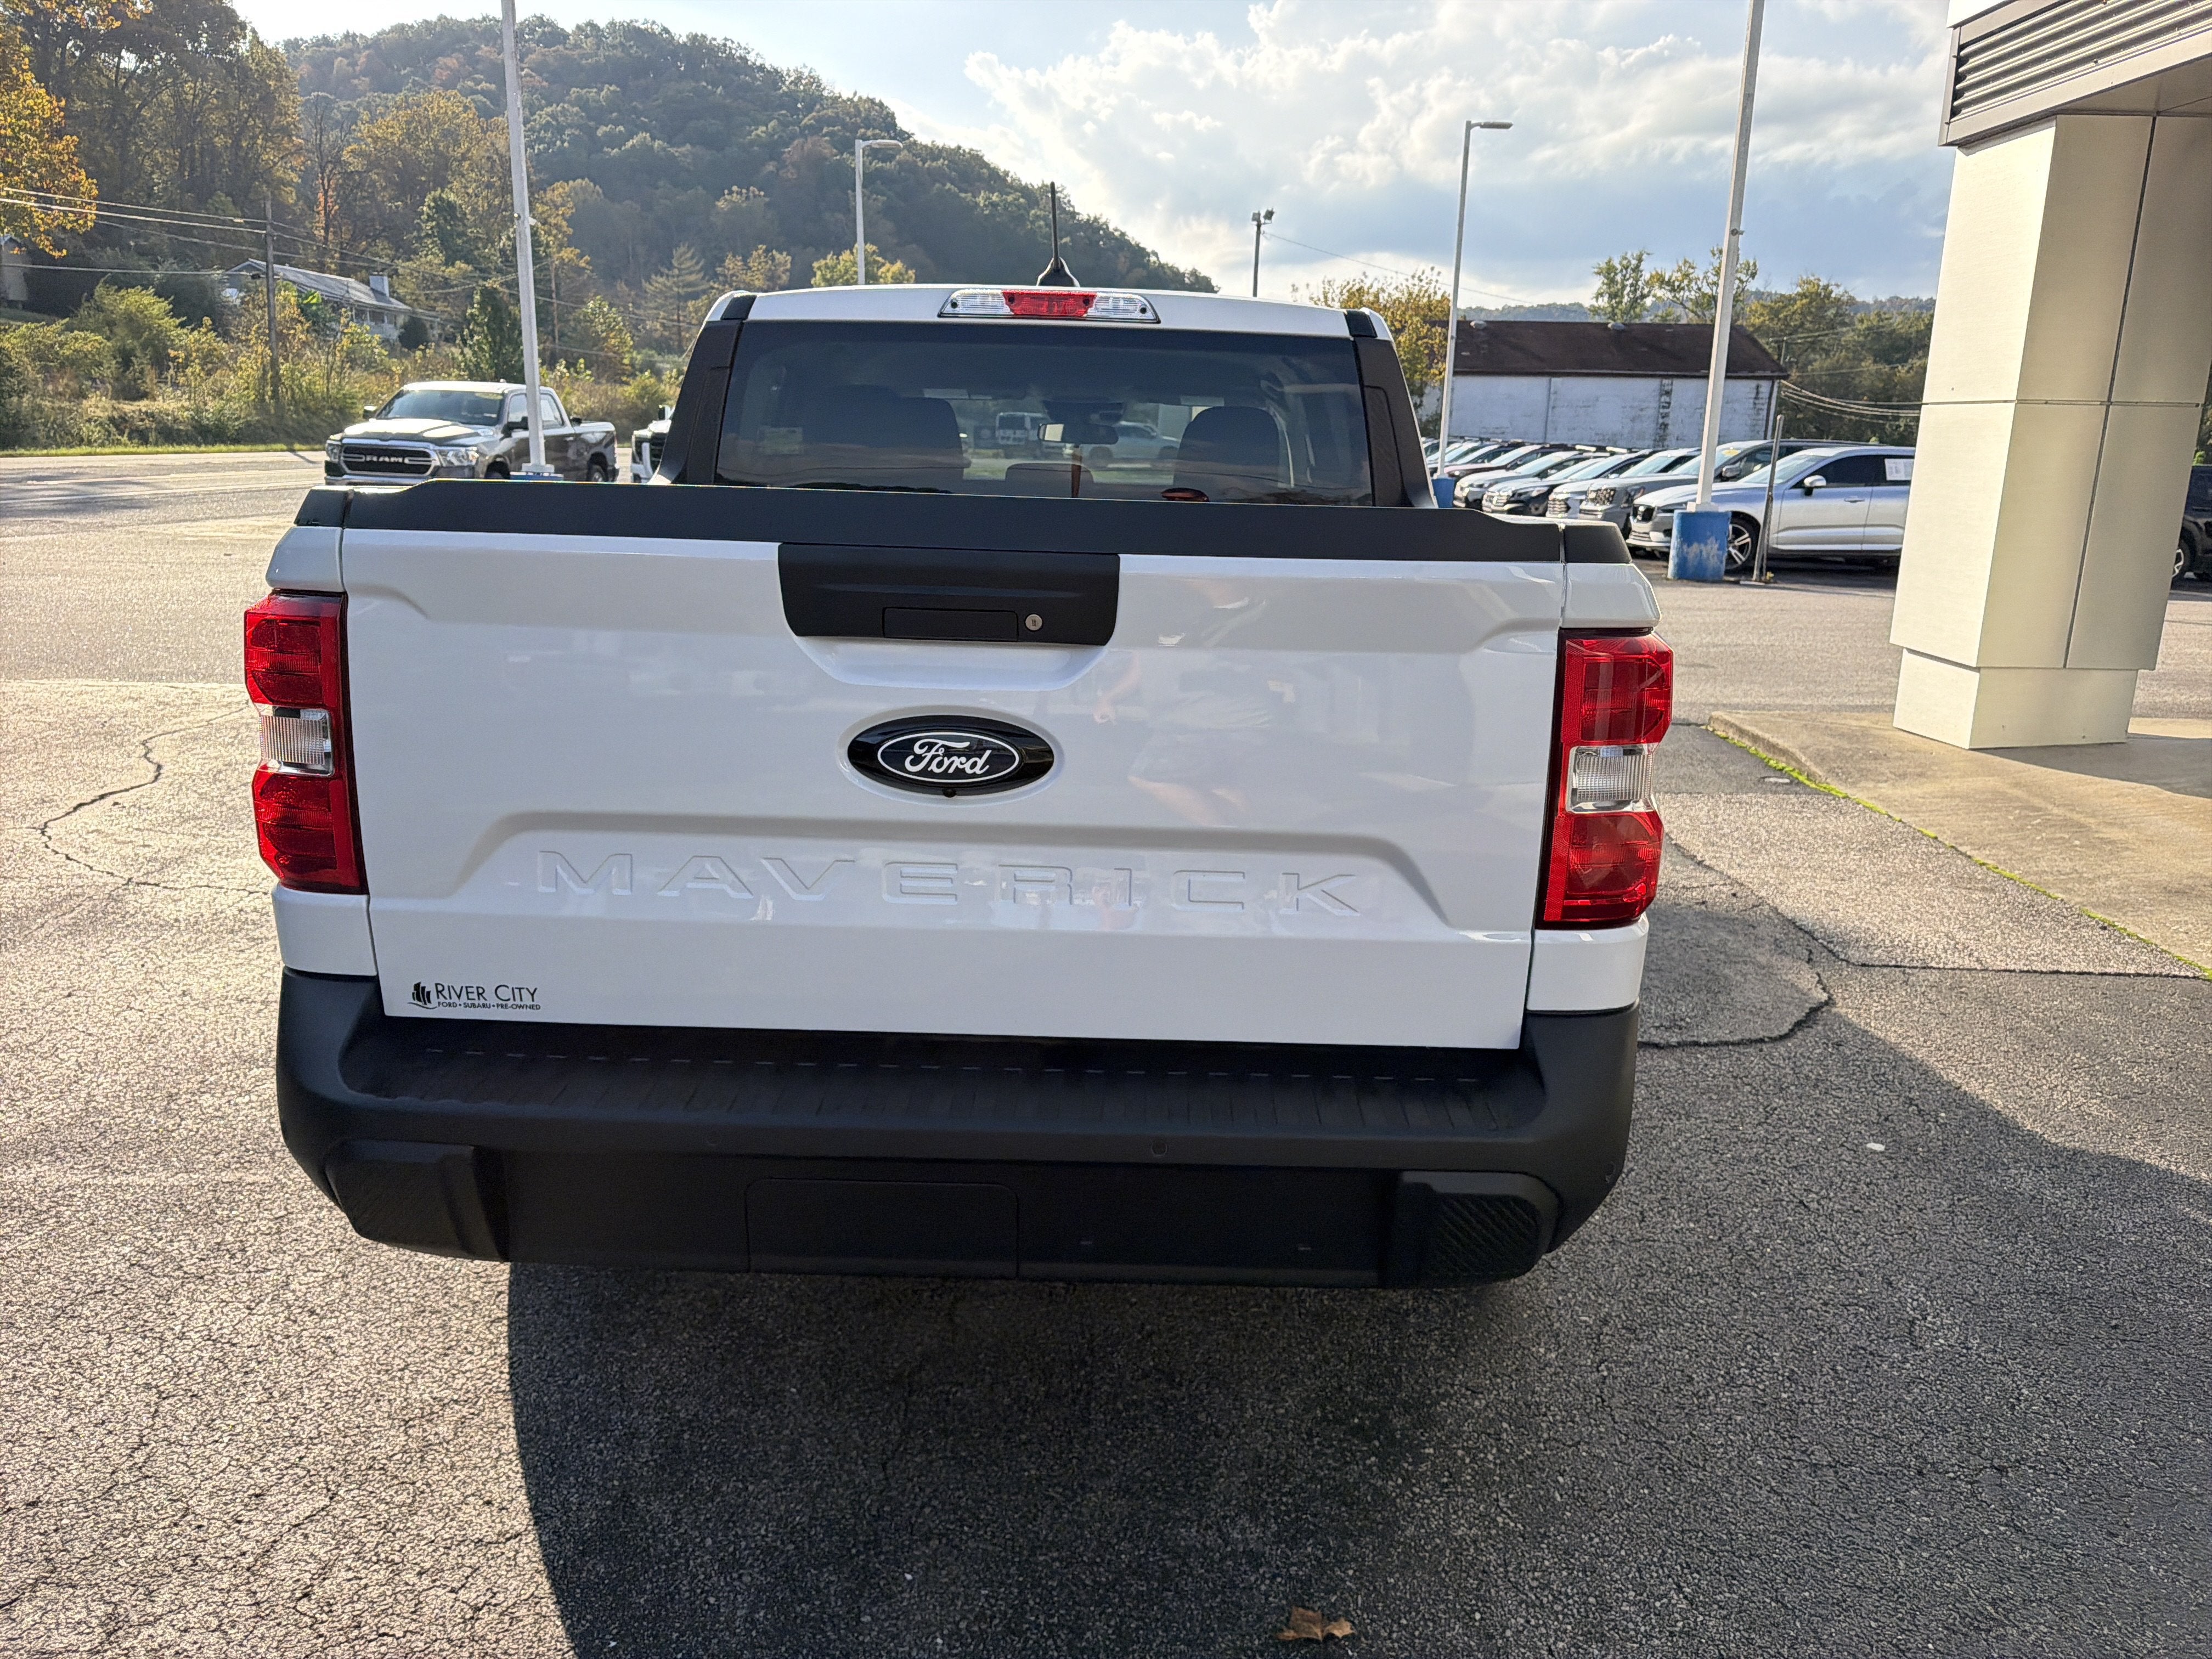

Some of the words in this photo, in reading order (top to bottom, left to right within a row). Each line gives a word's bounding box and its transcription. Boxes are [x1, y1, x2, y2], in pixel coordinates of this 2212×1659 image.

[904, 738, 990, 775] Ford
[537, 850, 1362, 917] MAVERICK
[434, 982, 488, 1001] RIVER
[494, 984, 538, 1002] CITY
